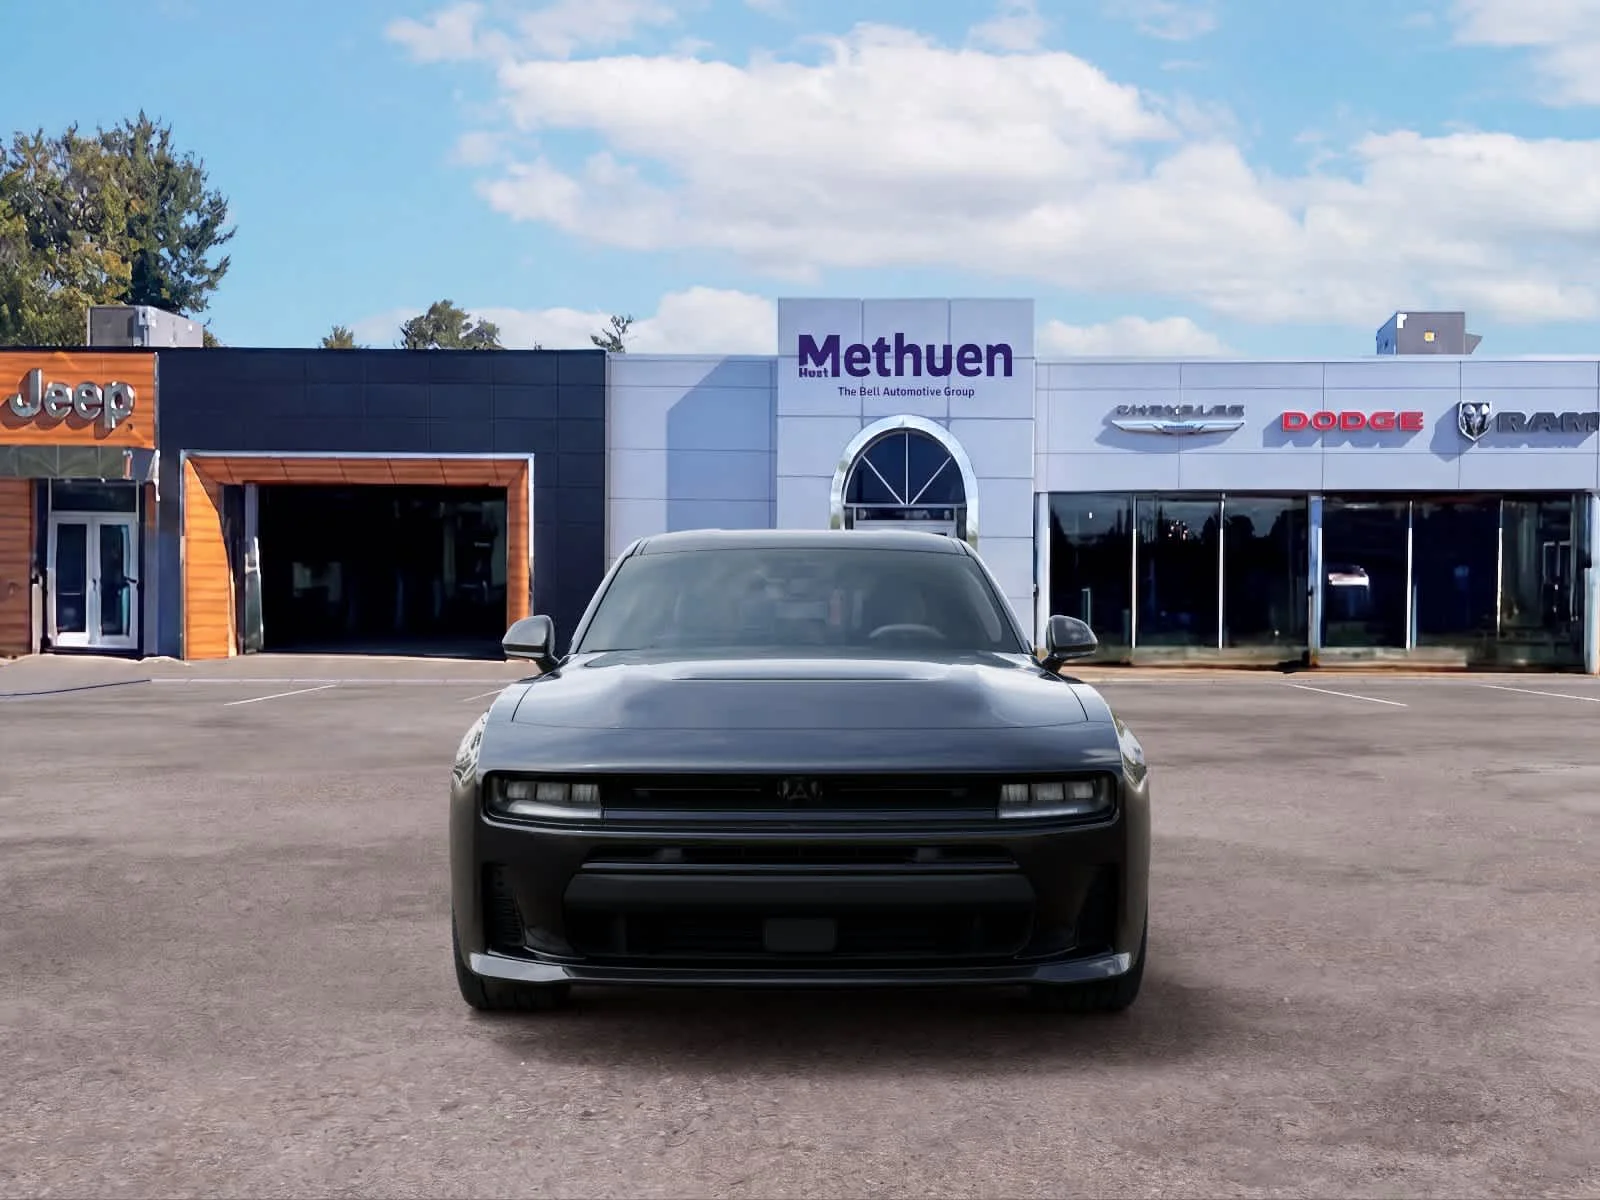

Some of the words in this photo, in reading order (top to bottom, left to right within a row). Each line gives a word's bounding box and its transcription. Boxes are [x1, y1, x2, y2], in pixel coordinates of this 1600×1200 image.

[799, 333, 1013, 378] Methuen
[9, 367, 136, 429] Jeep
[838, 386, 857, 397] The
[859, 386, 880, 397] Bell
[883, 386, 941, 397] Automotive
[943, 386, 975, 399] Group
[1281, 411, 1424, 432] DODGE
[1497, 411, 1600, 433] RAM
